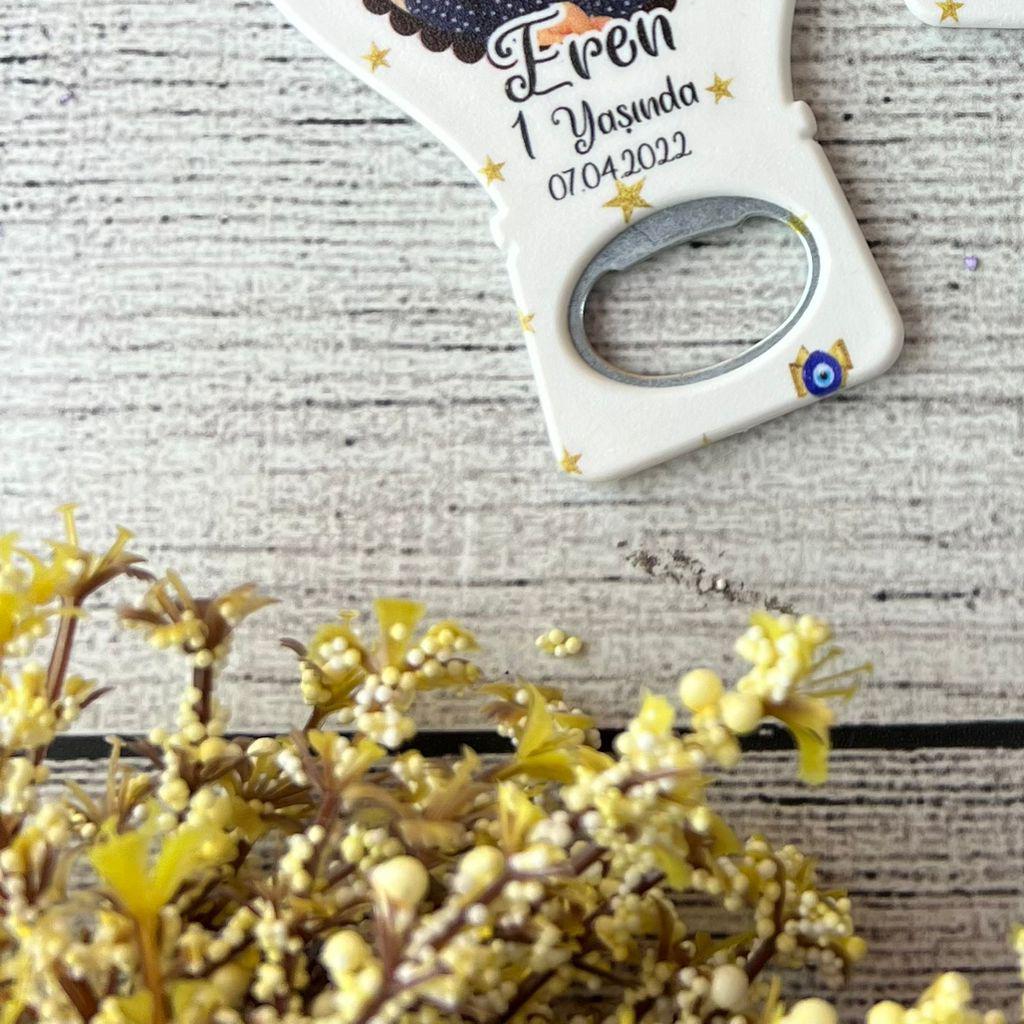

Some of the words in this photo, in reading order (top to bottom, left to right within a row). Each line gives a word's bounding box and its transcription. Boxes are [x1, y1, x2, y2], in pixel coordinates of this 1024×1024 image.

[494, 9, 677, 103] Eren
[511, 110, 536, 159] 1
[551, 75, 700, 155] Yaşında
[548, 130, 692, 201] 07.04.2022
